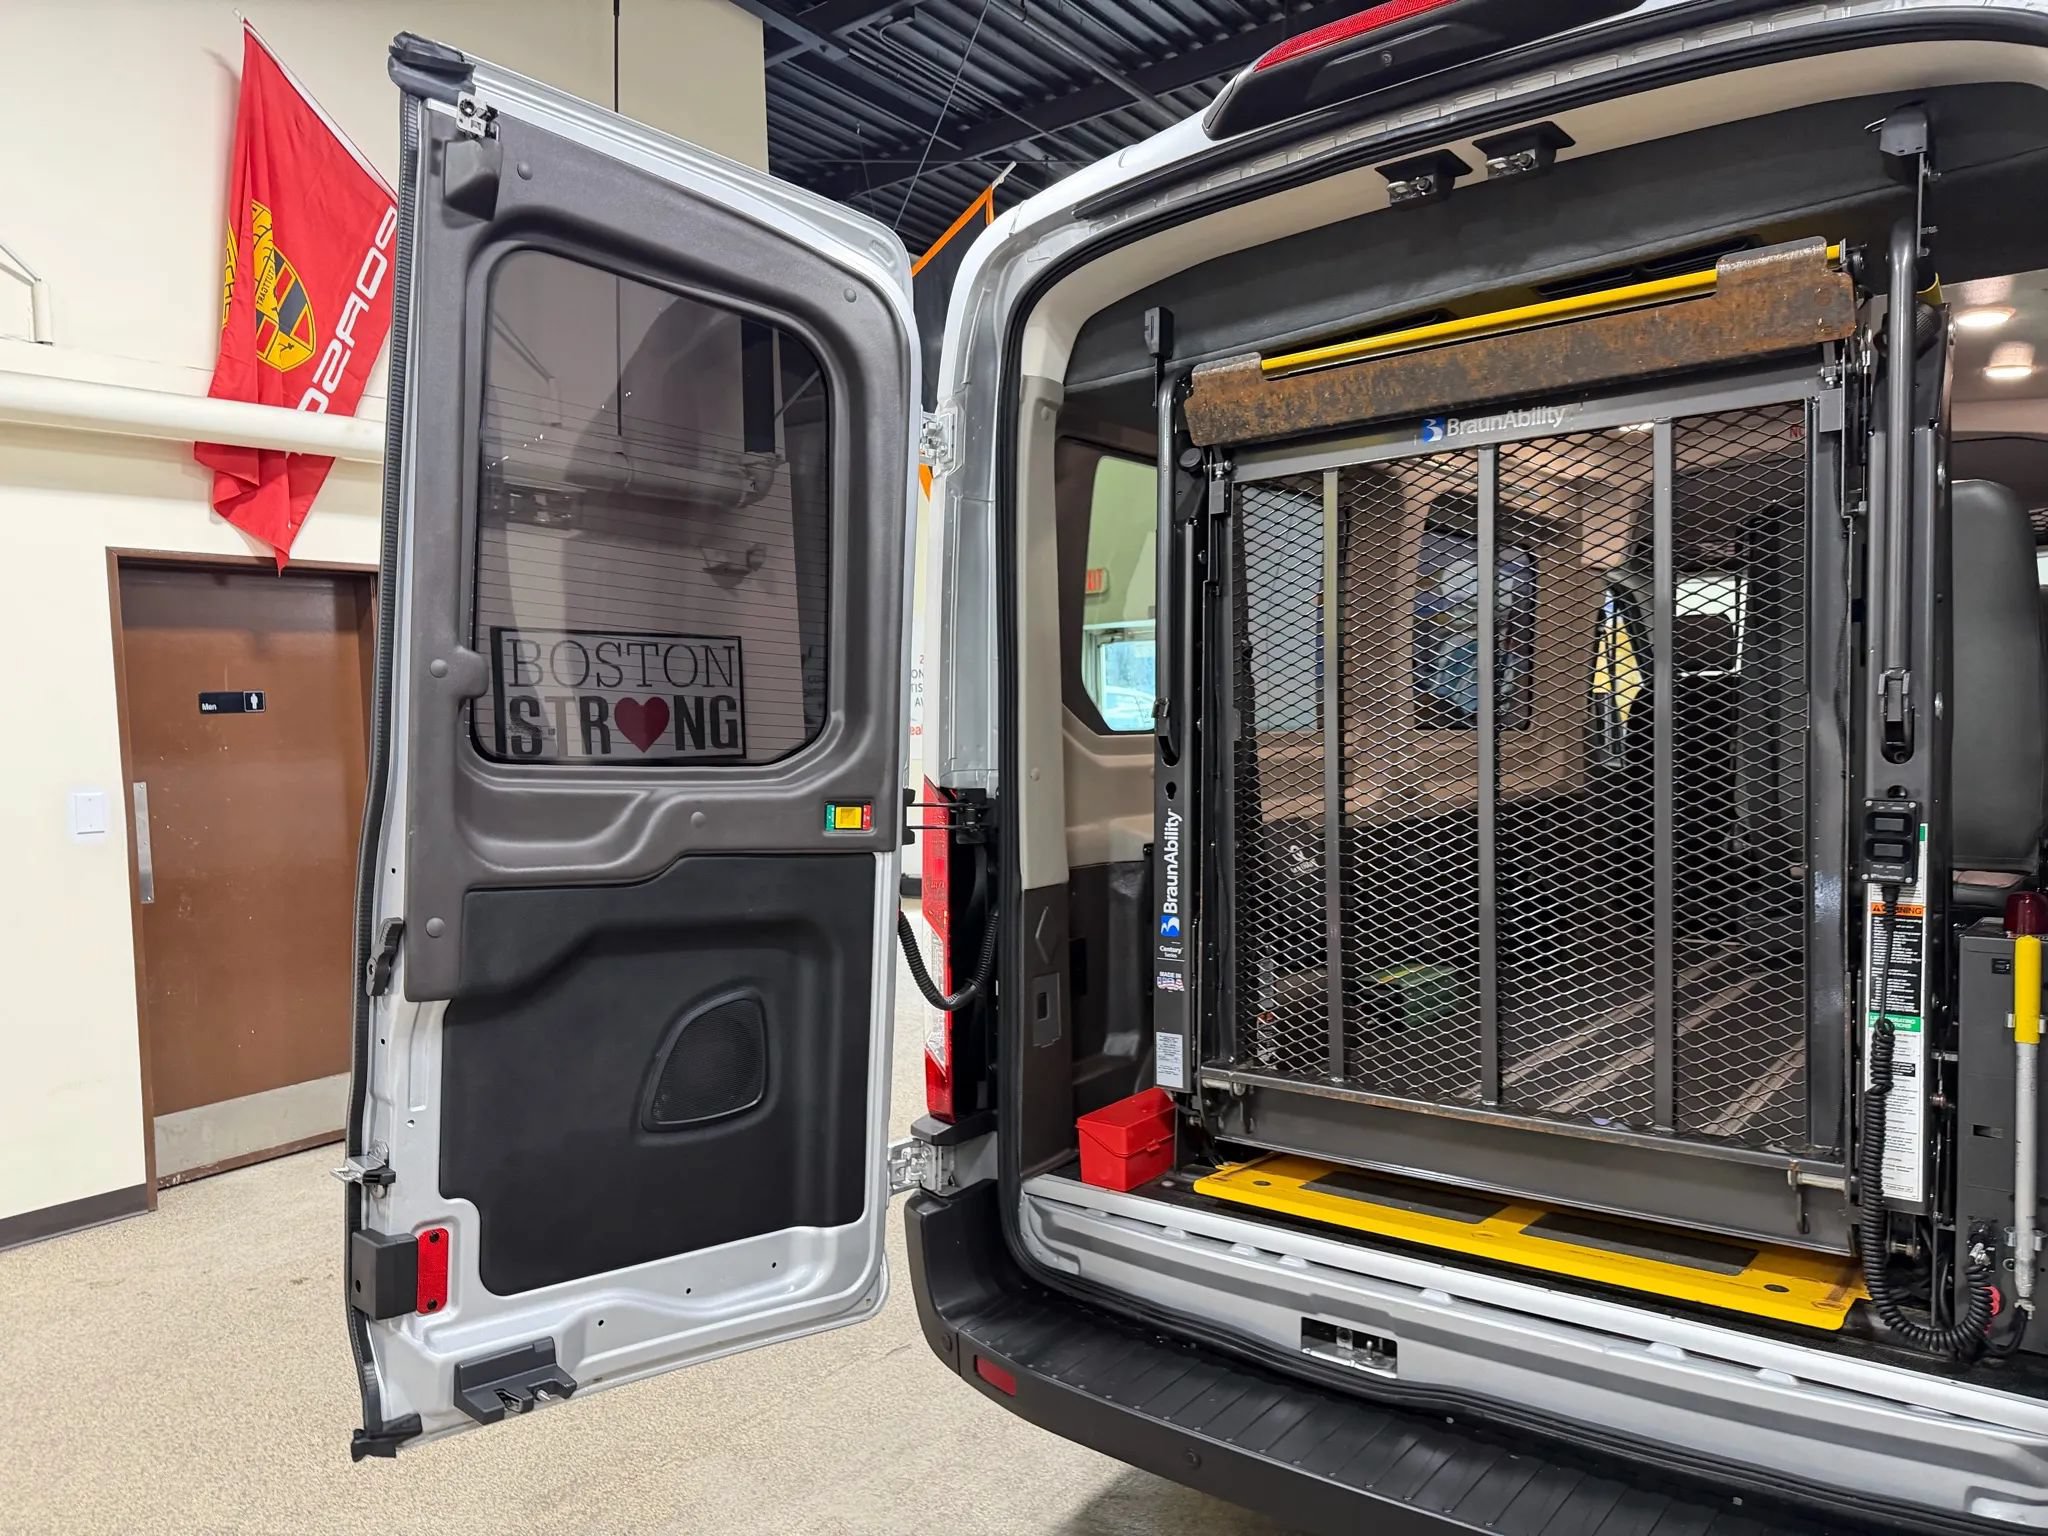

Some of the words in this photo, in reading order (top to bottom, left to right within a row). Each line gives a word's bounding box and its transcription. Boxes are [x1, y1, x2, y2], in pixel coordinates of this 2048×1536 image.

[1447, 406, 1566, 437] BraunAbility
[506, 638, 736, 689] BOSTON
[201, 702, 217, 711] Men
[1163, 809, 1183, 914] BraunAbility
